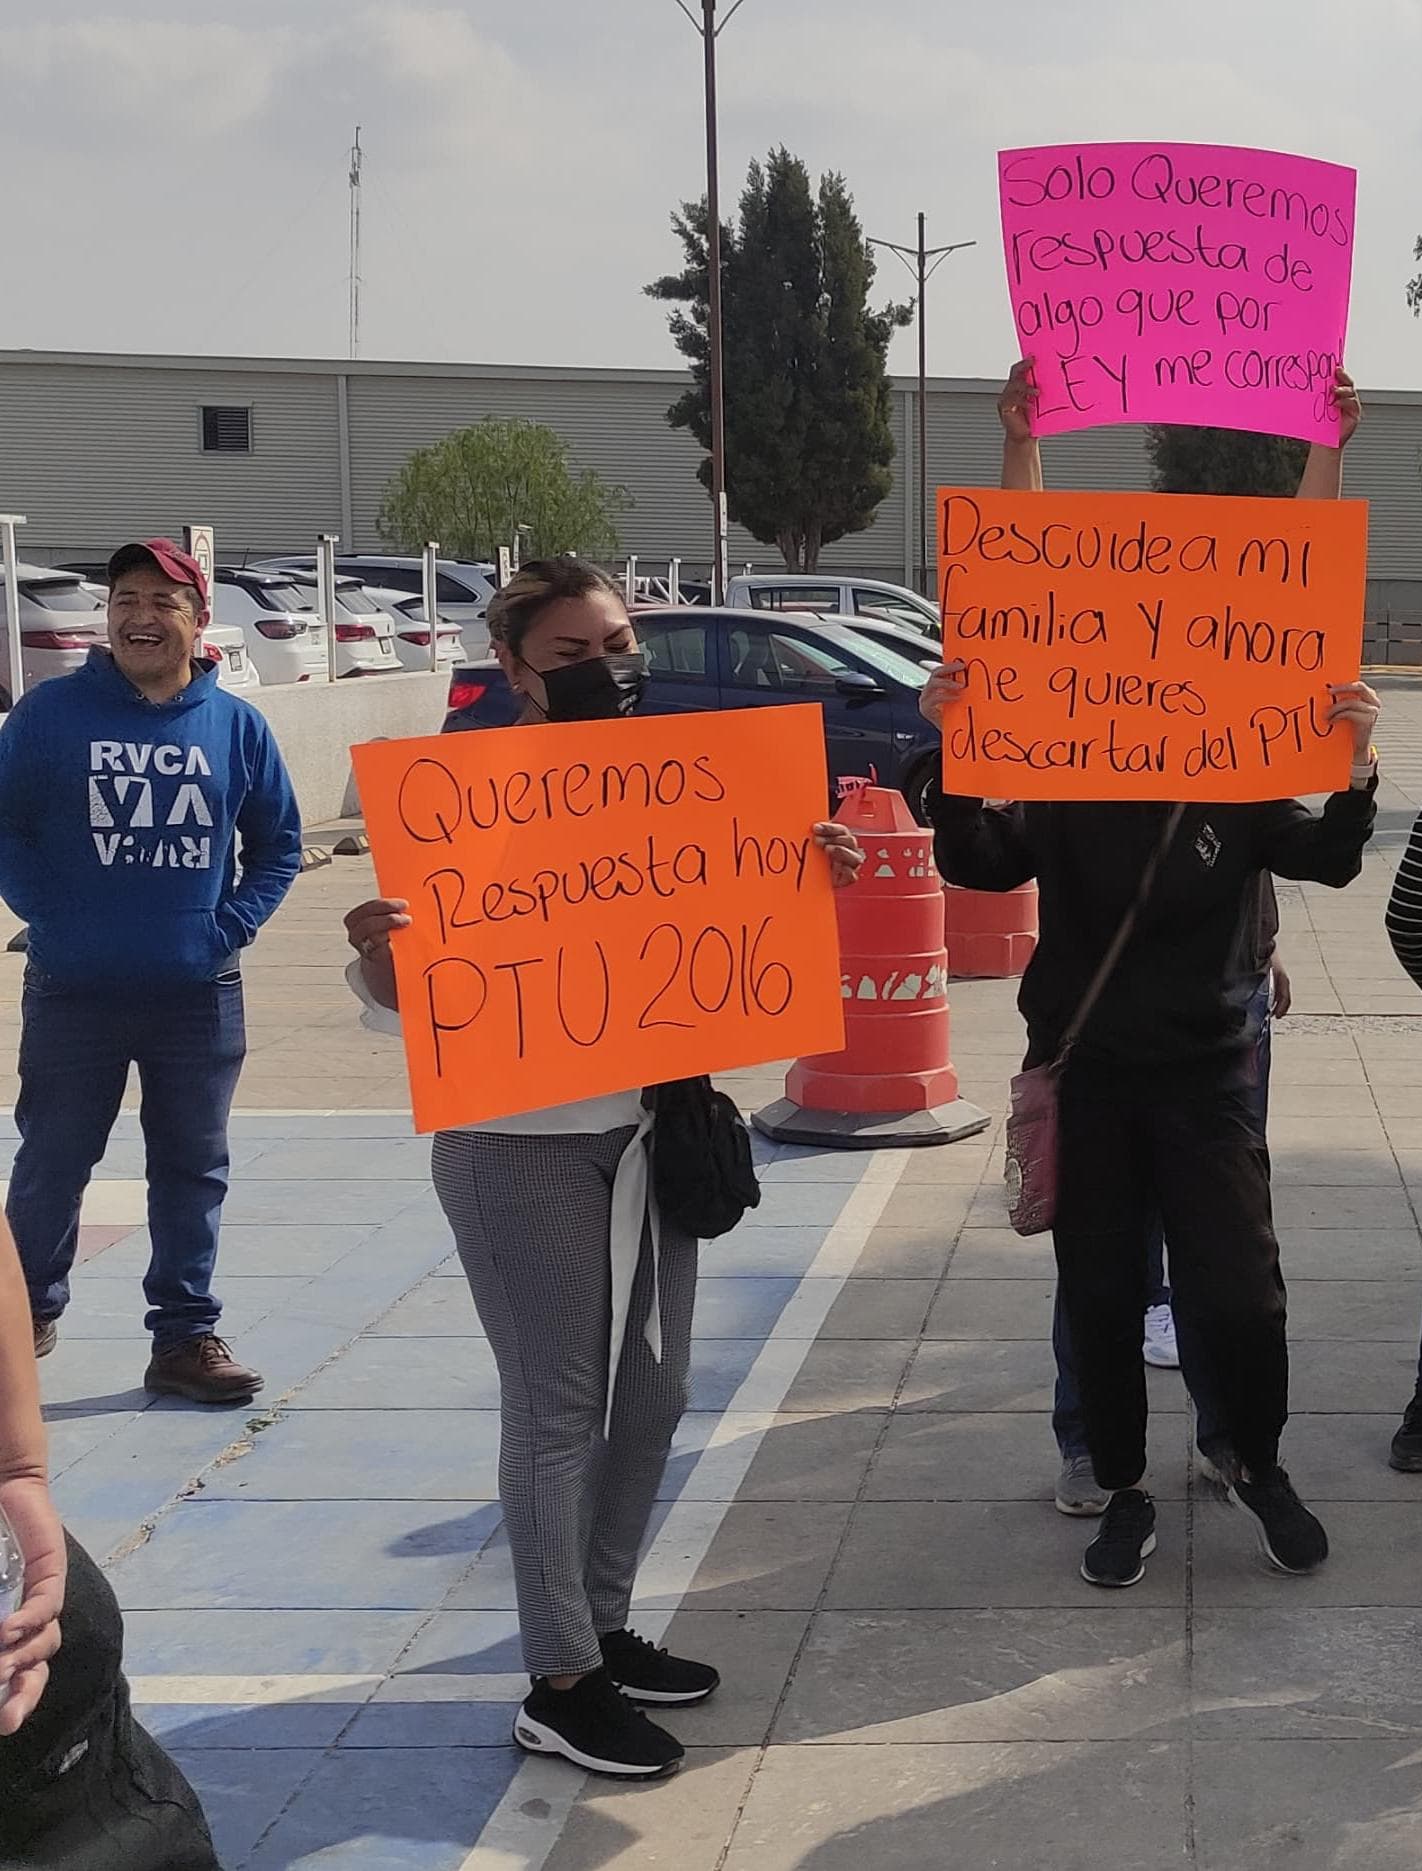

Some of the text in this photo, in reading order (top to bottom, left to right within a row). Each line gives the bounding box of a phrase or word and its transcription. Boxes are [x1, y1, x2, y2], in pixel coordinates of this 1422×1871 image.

[1003, 154, 1349, 247] Solo Queremos
[1012, 224, 1314, 291] respuesta de
[1018, 289, 1281, 358] algo que por
[1155, 350, 1213, 387] me
[942, 495, 1172, 575] Descuide
[1238, 527, 1311, 588] mi
[941, 563, 1108, 646] familia
[1186, 605, 1326, 671] ahora
[1048, 666, 1207, 718] quieres
[90, 740, 212, 776] RVCA
[950, 705, 1169, 773] descartar
[1184, 726, 1238, 778] del
[398, 755, 725, 844] Queremos
[422, 817, 811, 945] Respuesta hoy
[422, 916, 793, 1078] PTU 2016
